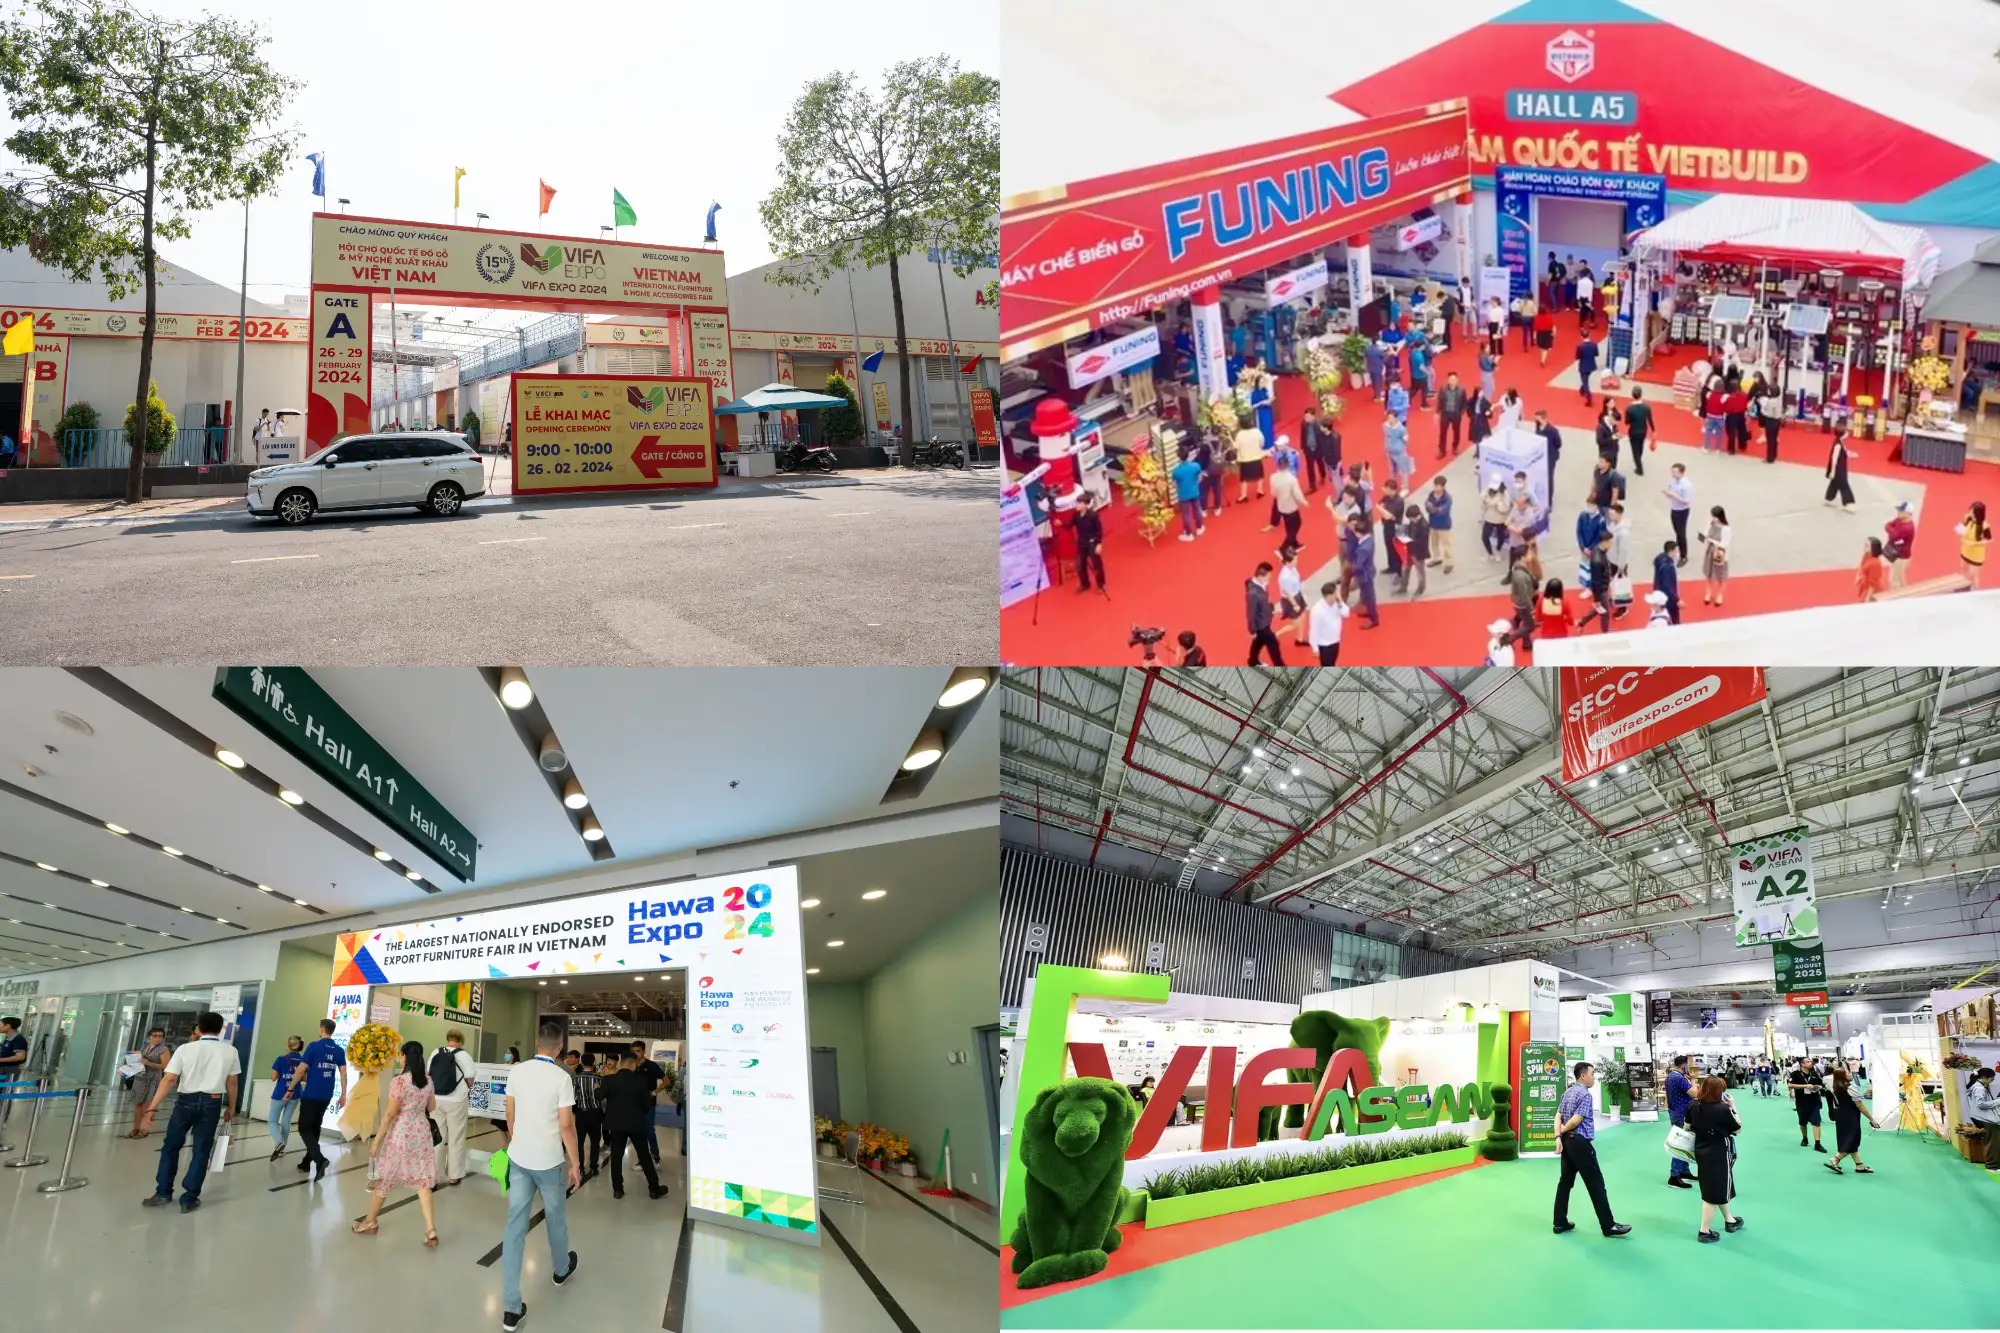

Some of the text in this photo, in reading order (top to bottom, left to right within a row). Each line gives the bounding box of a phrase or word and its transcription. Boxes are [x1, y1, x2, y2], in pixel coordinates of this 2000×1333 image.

[1517, 93, 1625, 120] HALL A5
[1512, 129, 1809, 184] QUỐC TẾ VIETBUILD
[1626, 176, 1661, 190] KHÁCH
[1161, 146, 1392, 265] FUNING
[339, 226, 448, 242] CHÀO MỪNG QUÝ KHÁCH
[338, 243, 355, 252] HỘI
[357, 245, 378, 253] CHỢ
[380, 245, 406, 256] QUỐC
[564, 246, 606, 265] VIFA
[338, 253, 346, 261] &
[348, 252, 364, 262] MỸ
[365, 254, 393, 264] NGHỆ
[395, 256, 421, 266] XUẤT
[485, 256, 509, 268] 15th
[642, 252, 690, 263] WELCOME TO
[352, 265, 436, 283] VIỆT NAM
[564, 264, 606, 280] EXPO
[633, 267, 701, 284] VIETNAM
[1296, 263, 1326, 283] FUNING
[1350, 258, 1360, 301] FUNING
[521, 280, 607, 295] VIFA EXPO 2024
[622, 281, 713, 293] INTERNATIONAL FURNITURE
[324, 297, 359, 308] GATE
[630, 290, 651, 298] HOME
[653, 291, 697, 300] ACCESSORIES
[1099, 269, 1233, 324] http://Funing.com.vn
[158, 317, 178, 325] VIFA
[197, 318, 207, 326] 26
[326, 312, 357, 339] A
[196, 327, 224, 337] FEB
[228, 320, 290, 339] 2024
[817, 341, 837, 350] 2024
[932, 341, 961, 354] 204
[1112, 331, 1157, 356] FUNING
[1197, 319, 1208, 369] FUNING
[320, 347, 363, 358] 26 29
[697, 358, 727, 367] 26 29
[35, 361, 58, 381] B
[318, 370, 362, 383] 2024
[699, 369, 722, 377] THÁNG
[781, 368, 792, 380] A
[845, 369, 856, 380] A
[665, 386, 702, 403] VIFA
[525, 405, 611, 423] LỄ KHAI MẠC
[666, 403, 703, 417] EXPO
[525, 424, 611, 433] OPENING CEREMONY
[629, 421, 704, 430] VIFA EXPO 2024
[526, 442, 613, 457] 9:00 10:00
[641, 451, 663, 461] GATE
[526, 461, 613, 475] 26 02 2024
[1568, 671, 1639, 723] SECC
[1591, 704, 1616, 721] District 7
[1611, 685, 1709, 737] vifaexpo.com
[305, 714, 382, 795] Hall A1
[410, 804, 457, 857] Hall A2
[1767, 847, 1801, 862] VIFA
[1768, 857, 1803, 869] ASEAN
[1741, 879, 1758, 887] HALL
[1756, 869, 1809, 901] A2
[722, 883, 773, 912] 20
[628, 895, 715, 922] Hawa
[385, 915, 614, 952] THE LARGEST NATIONALLY ENDORSED
[628, 921, 703, 946] Expo
[723, 911, 775, 941] 24
[383, 934, 607, 966] EXPORT FURNITURE FAIR IN VIETNAM
[1352, 957, 1387, 983] A2
[1795, 969, 1823, 978] 2025
[334, 994, 362, 1005] HAWA
[700, 990, 734, 999] Hawa
[700, 999, 730, 1010] Expo
[445, 1011, 481, 1026] TAN MINH TIEN
[1461, 1026, 1477, 1034] FAIR
[1526, 1064, 1543, 1075] SPIN
[1068, 1043, 1384, 1161] VIFA
[1307, 1082, 1493, 1141] ASEAN
